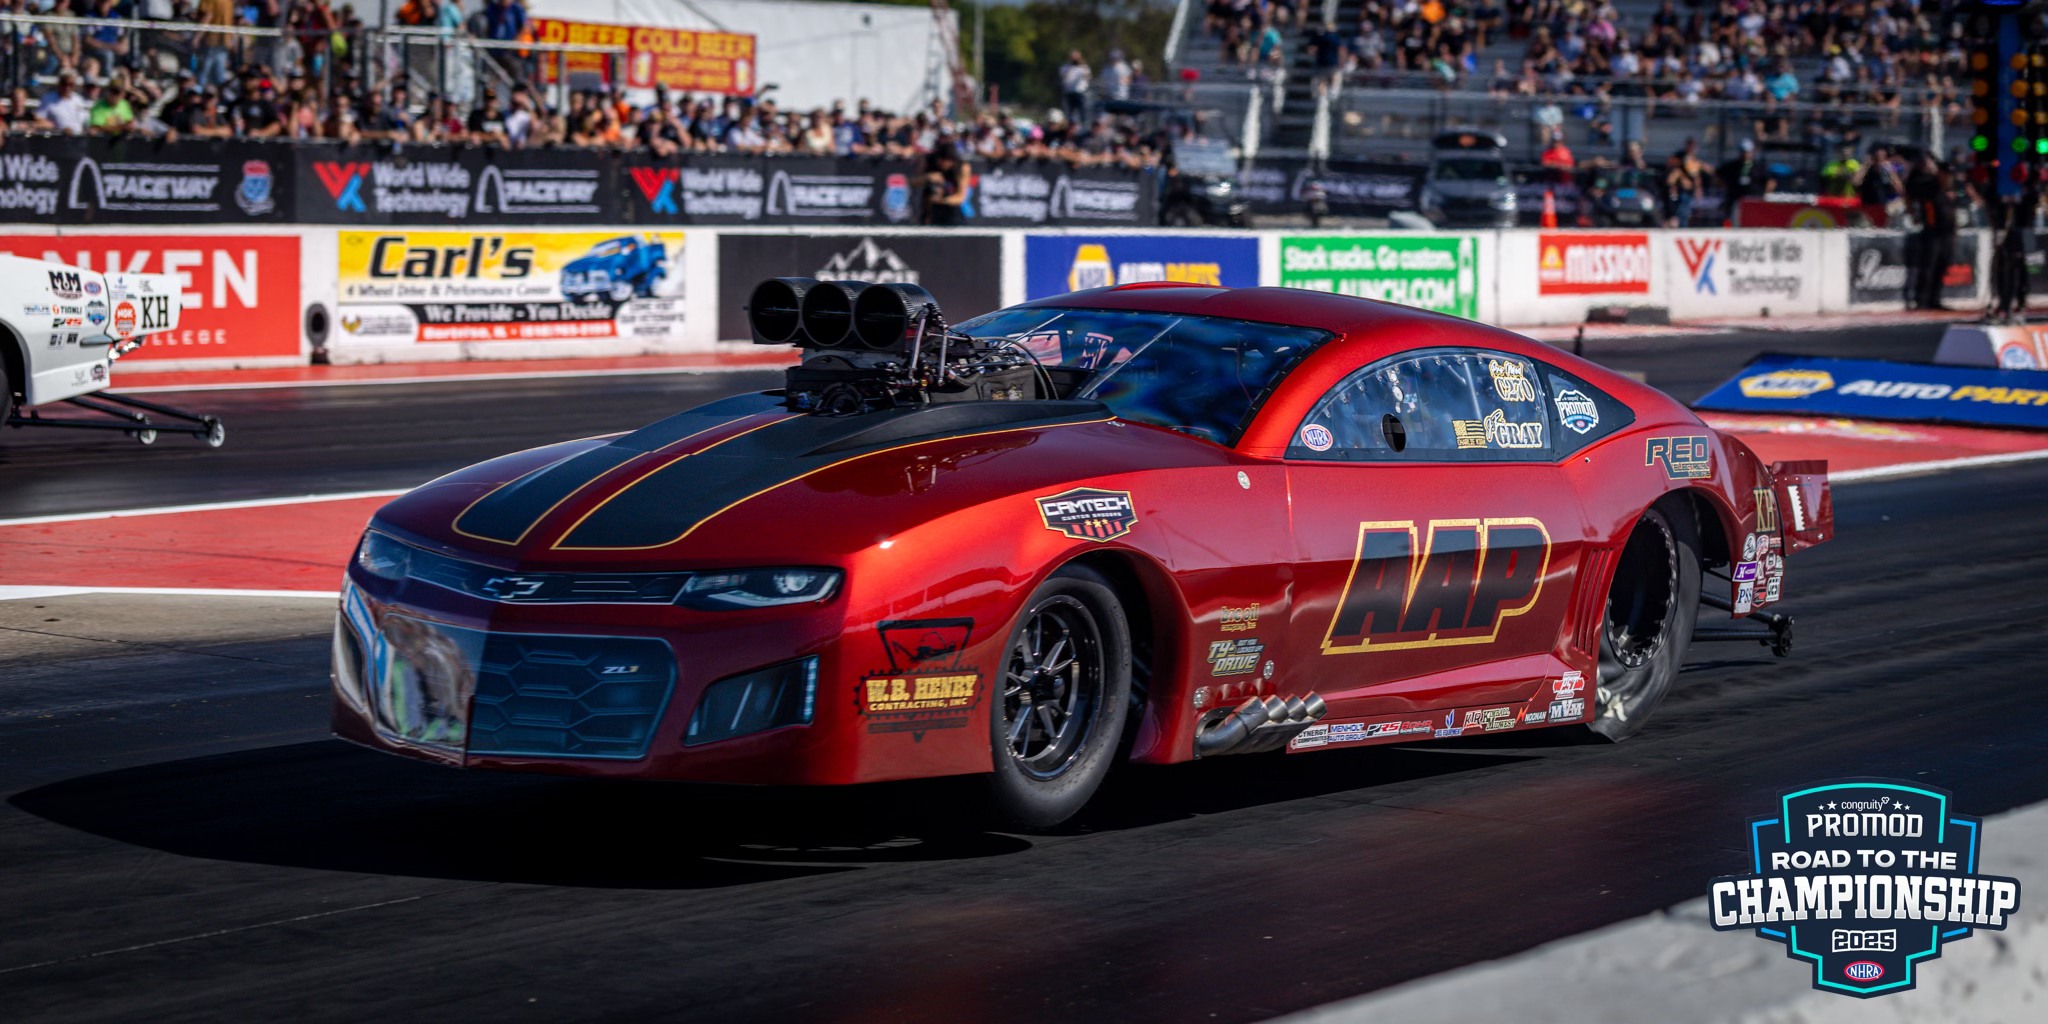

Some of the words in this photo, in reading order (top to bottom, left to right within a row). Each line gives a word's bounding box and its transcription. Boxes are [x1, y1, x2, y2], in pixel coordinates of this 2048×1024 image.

[633, 28, 694, 54] COLD
[4, 153, 59, 183] Wide
[373, 161, 421, 188] World
[425, 162, 470, 188] Wide
[104, 174, 217, 199] RACEWAY
[504, 181, 597, 202] RACEWAY
[373, 189, 470, 218] Technology
[368, 236, 534, 279] Carl's
[1565, 245, 1648, 283] MISSION
[141, 295, 169, 329] KH
[423, 304, 450, 323] We
[453, 304, 514, 323] Provide
[526, 303, 559, 321] You
[560, 301, 613, 321] Decide
[1838, 379, 1952, 399] AUTO
[1557, 401, 1597, 420] PROMOD
[1304, 429, 1329, 446] NHRA
[1496, 423, 1542, 447] GRAY
[1042, 497, 1130, 517] CAMTECH
[1327, 522, 1548, 646] AAP
[601, 665, 640, 674] ZL1
[1213, 654, 1260, 675] DRIVE
[913, 674, 978, 701] HENRY
[869, 700, 948, 711] CONTRACTING,
[1402, 720, 1434, 731] BOHR
[1525, 711, 1547, 722] NOONAN
[1328, 734, 1345, 742] AUTO
[1345, 733, 1366, 741] GROUP
[1331, 723, 1365, 733] MENHOLT
